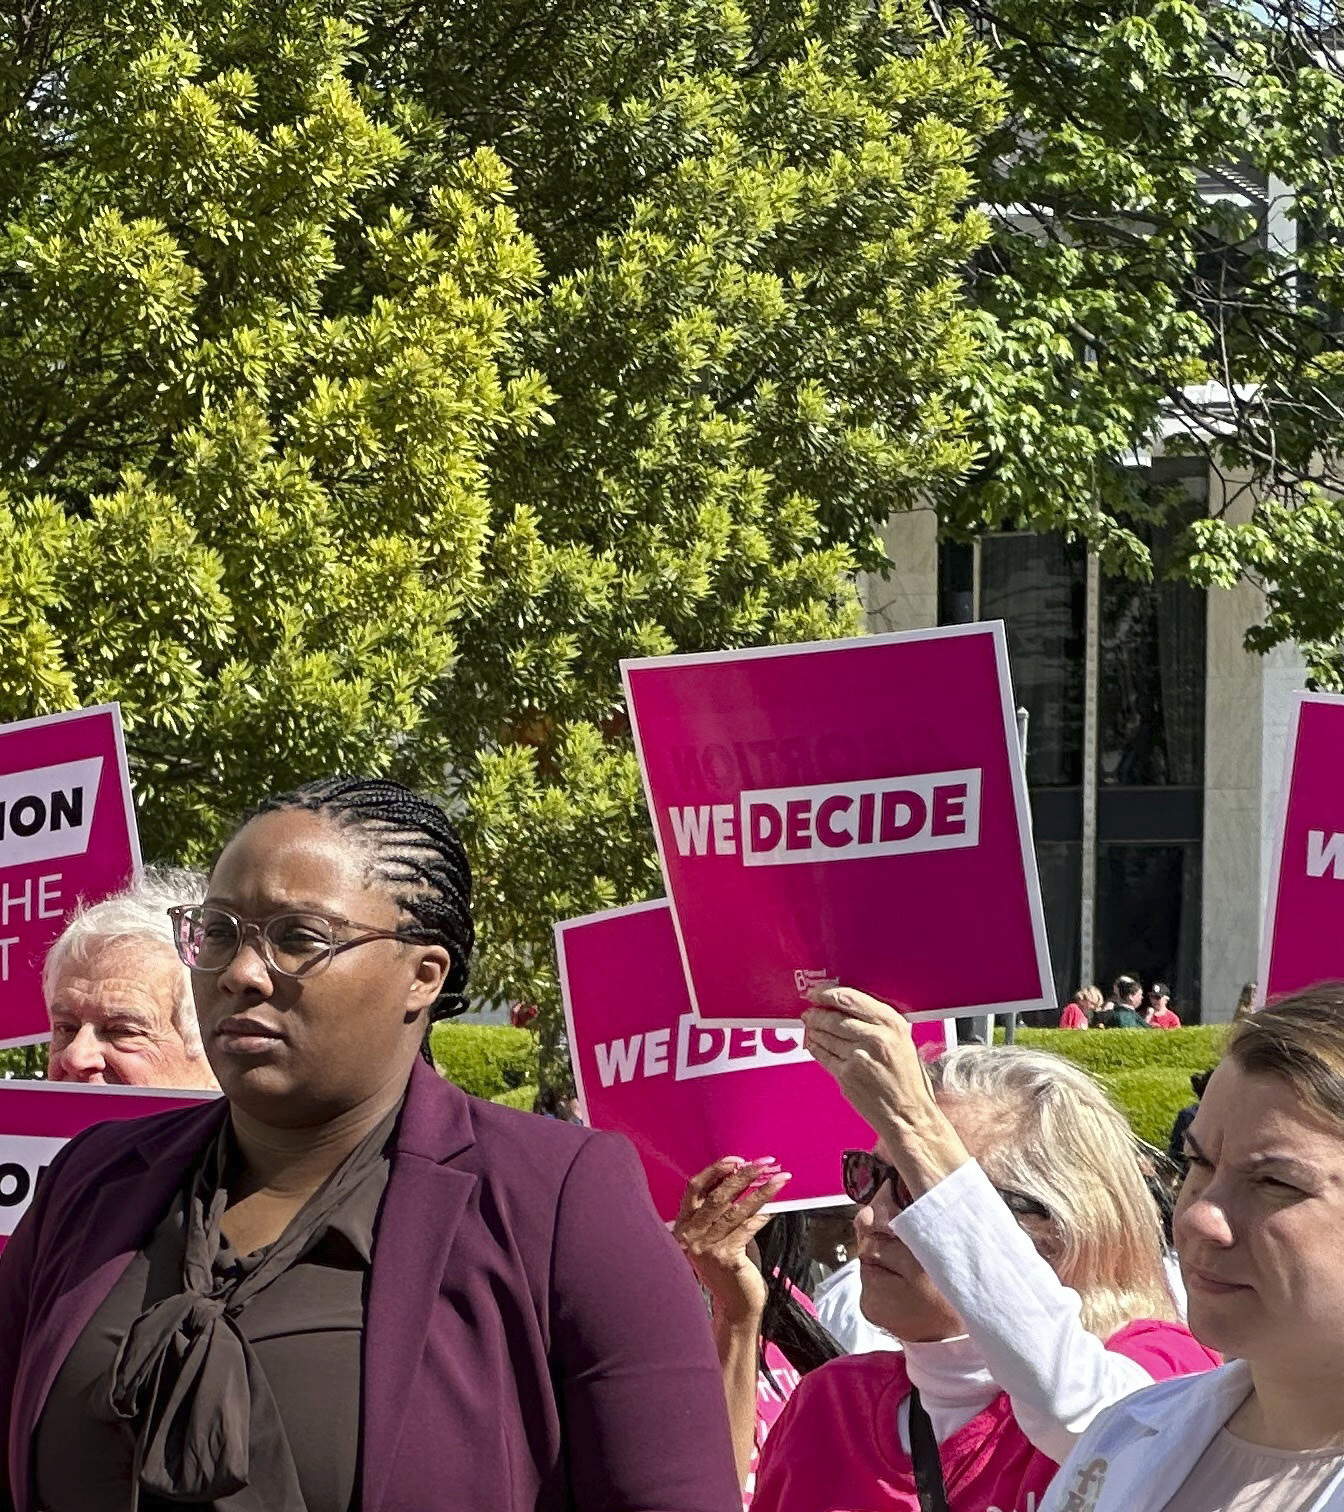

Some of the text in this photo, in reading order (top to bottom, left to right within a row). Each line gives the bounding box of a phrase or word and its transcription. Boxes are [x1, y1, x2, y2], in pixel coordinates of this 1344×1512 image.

[668, 783, 968, 857] WE DECIDE
[1306, 829, 1344, 880] W
[594, 1024, 799, 1088] WE DEC
